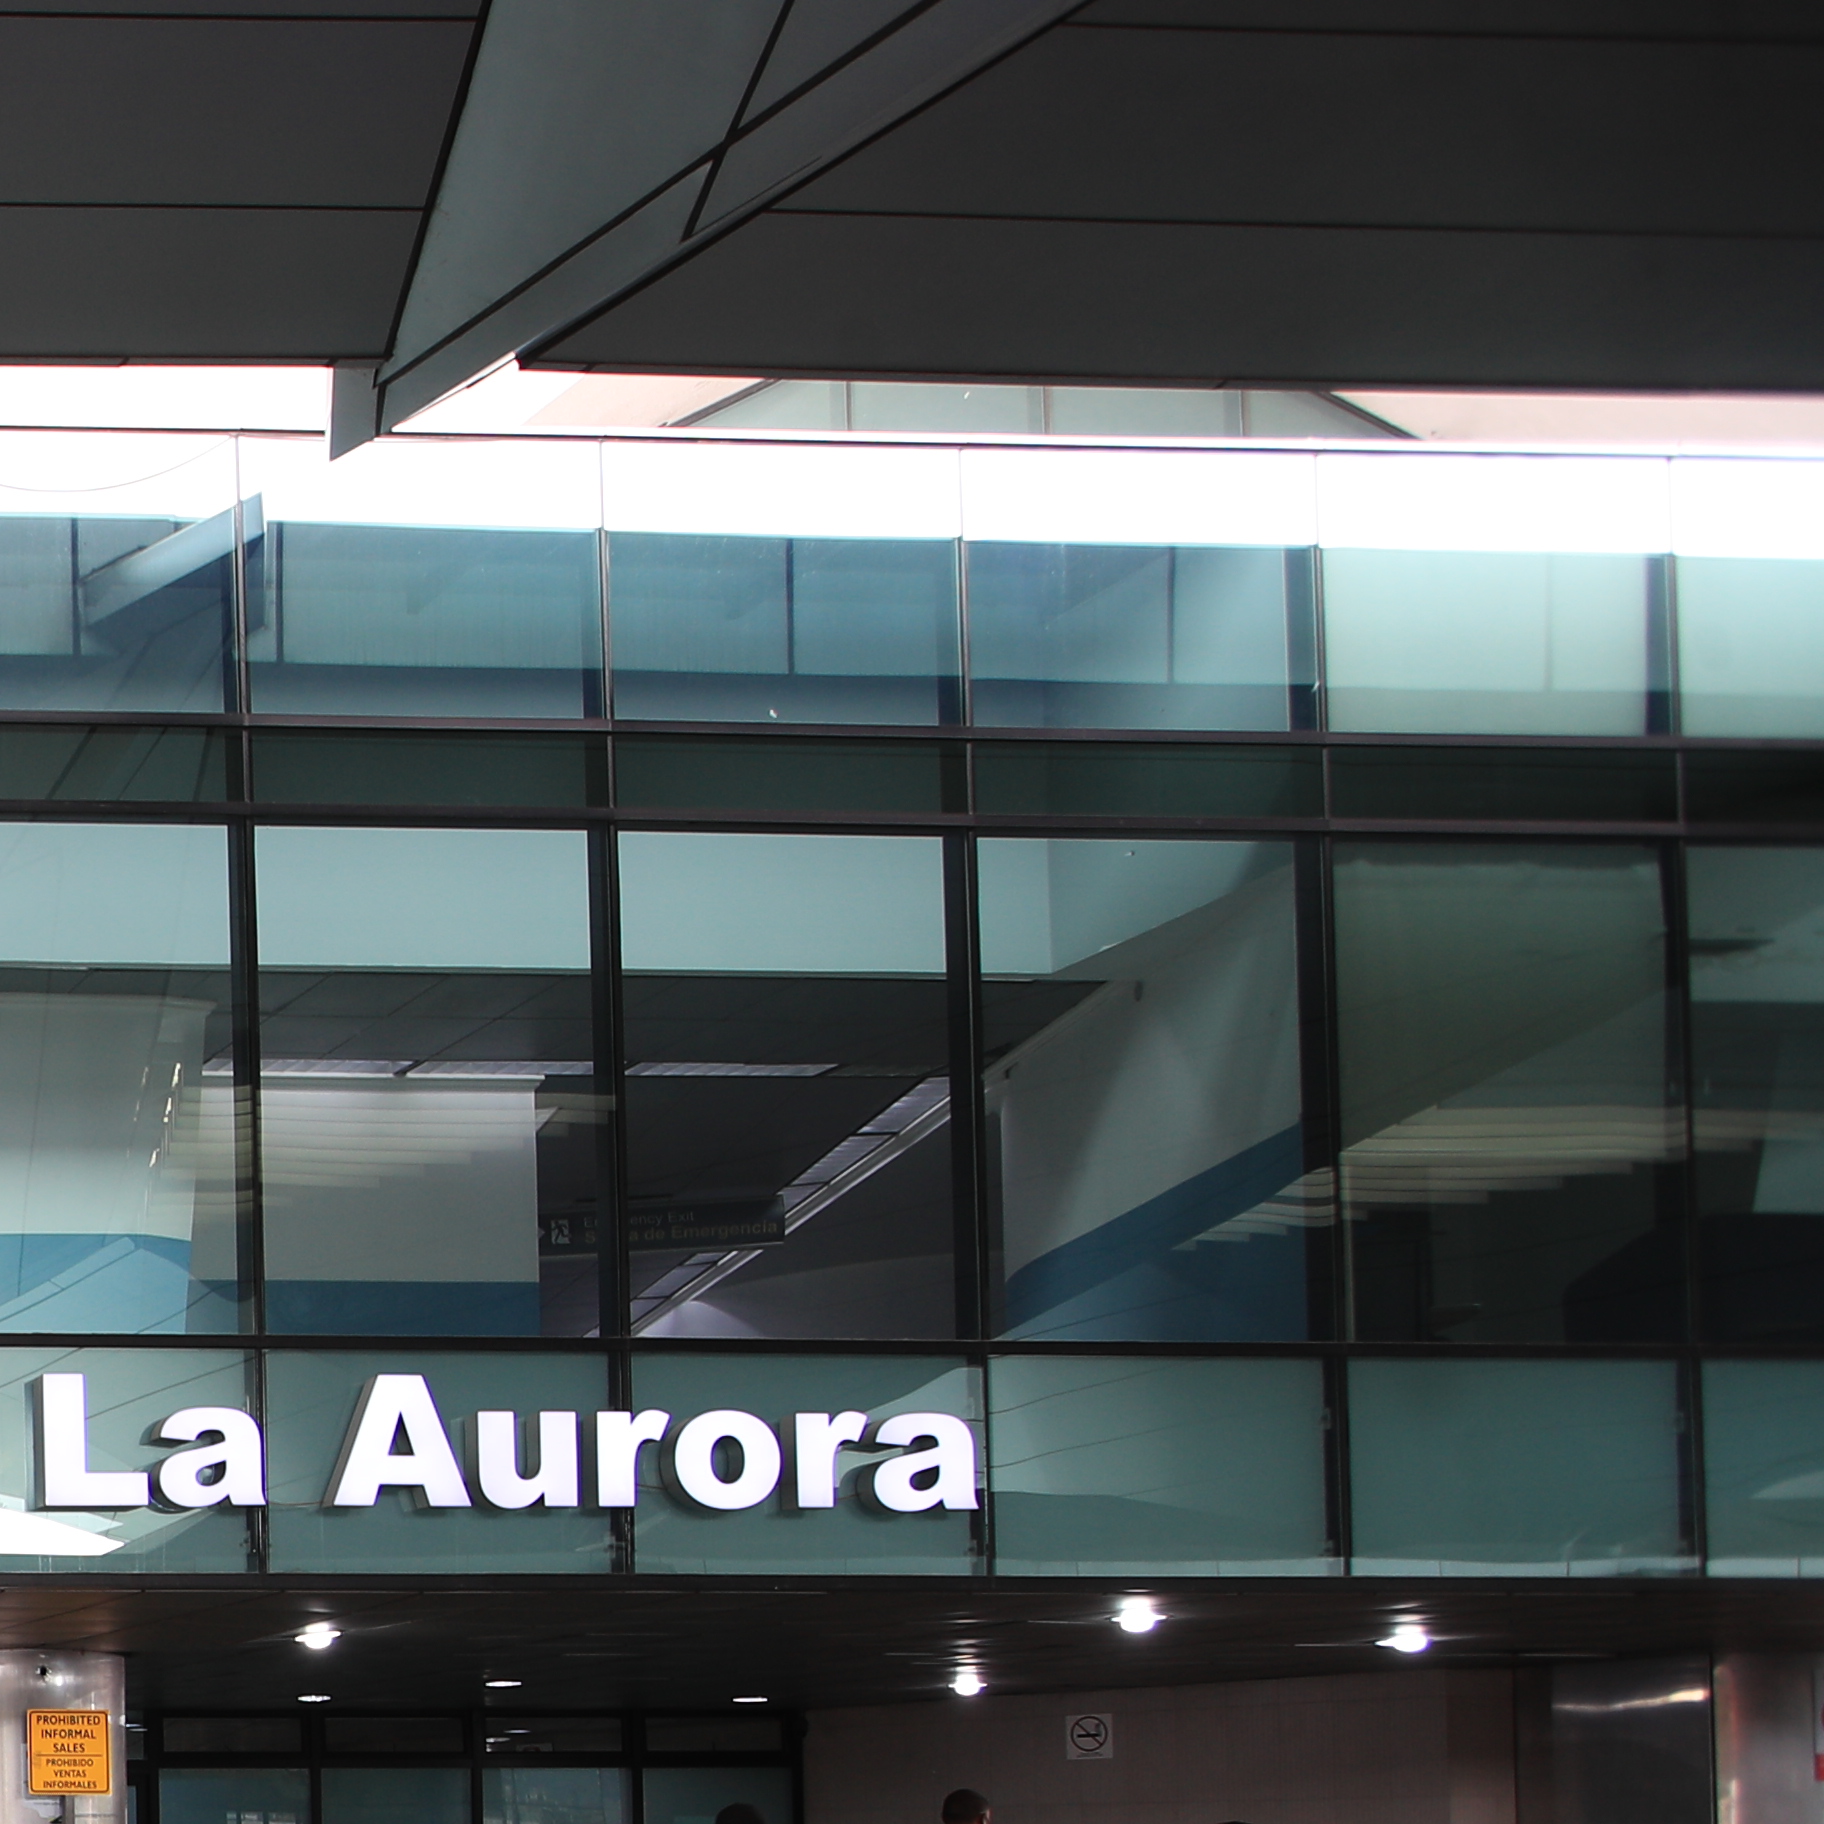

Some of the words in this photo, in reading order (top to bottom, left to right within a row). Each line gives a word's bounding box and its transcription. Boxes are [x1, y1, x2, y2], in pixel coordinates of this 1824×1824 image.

[668, 1211, 695, 1223] Exit
[645, 1227, 665, 1241] de
[671, 1219, 779, 1241] Emergencia
[32, 1373, 266, 1511] La
[328, 1373, 980, 1512] Aurora
[36, 1715, 101, 1726] PROHIBITED
[41, 1729, 97, 1740] INFORMAL
[53, 1742, 86, 1754] SALES
[45, 1758, 94, 1767] PROHIBIDO
[53, 1769, 87, 1778] VENTAS
[43, 1780, 97, 1789] INFORMALES
